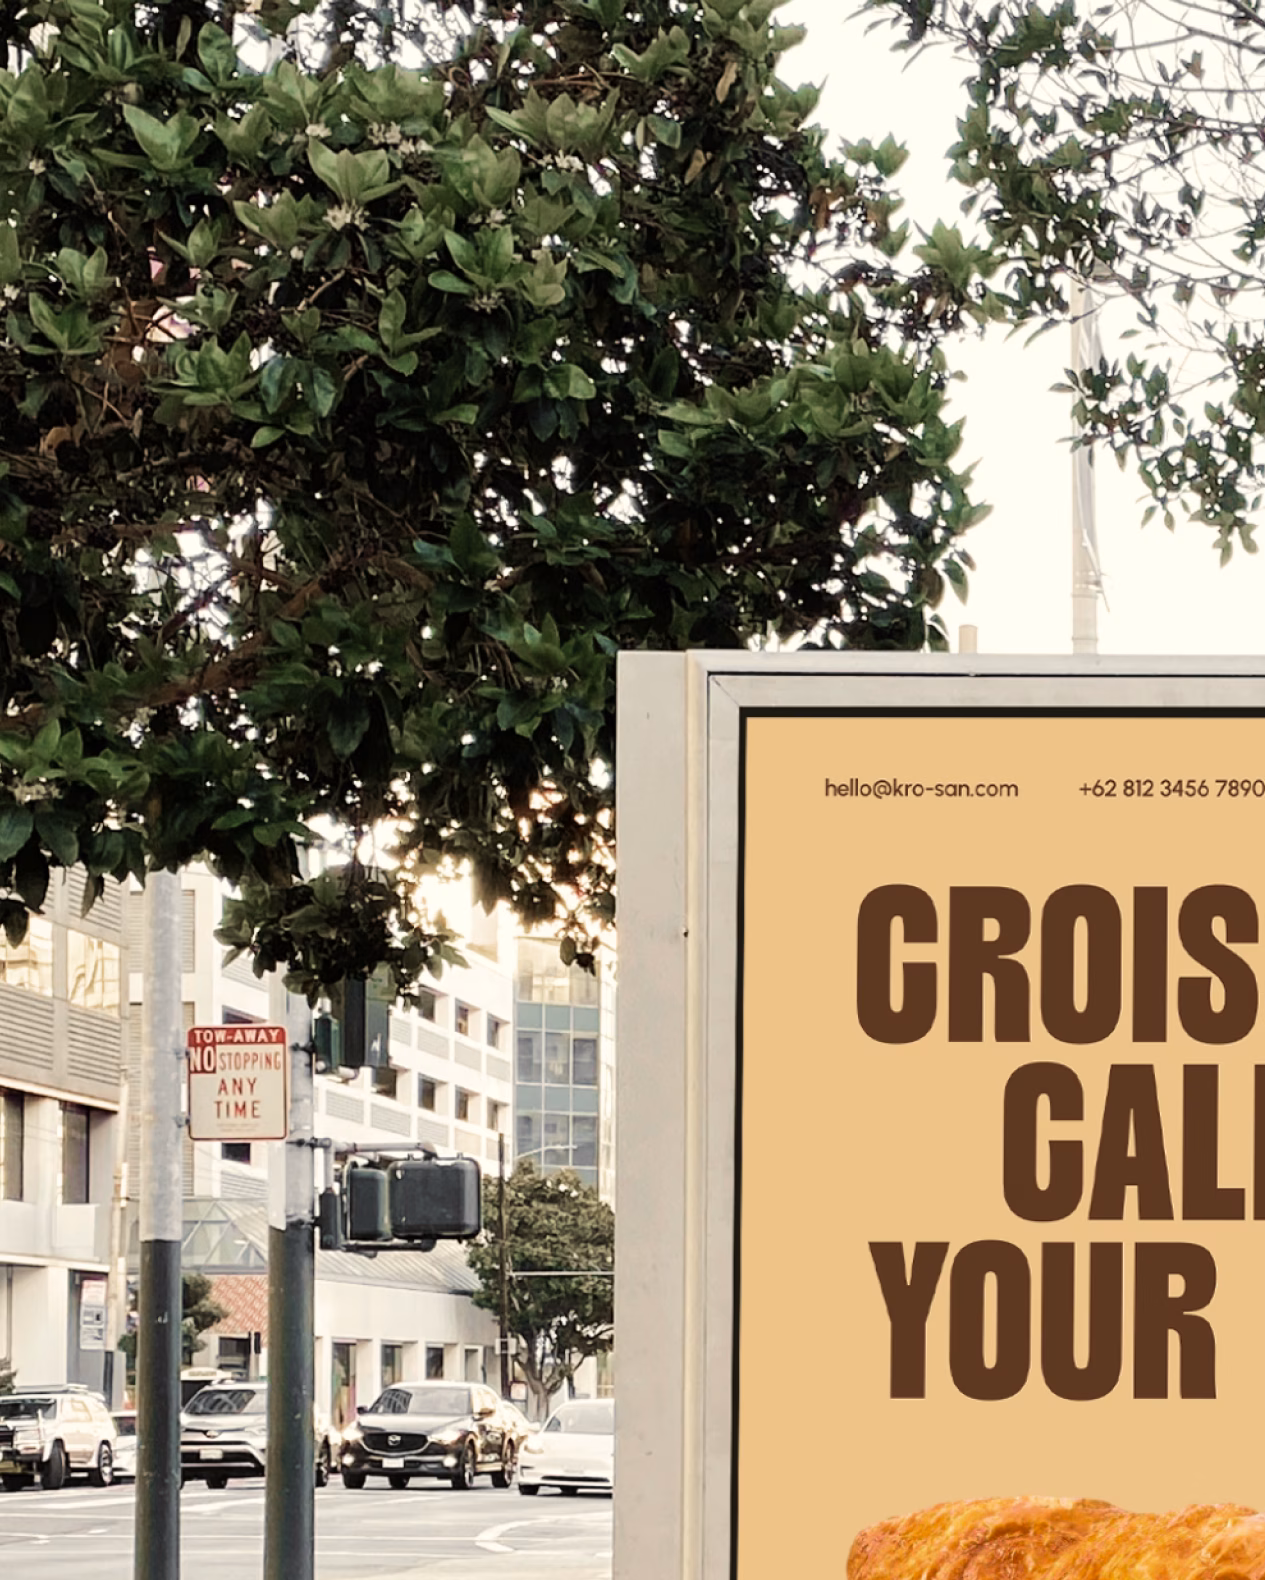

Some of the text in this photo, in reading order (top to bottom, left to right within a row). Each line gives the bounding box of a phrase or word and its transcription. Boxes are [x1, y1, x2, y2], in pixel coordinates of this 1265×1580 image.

[824, 778, 1019, 800] hello@kro-san.com
[1078, 778, 1265, 798] +62 812 3456 7890
[194, 1029, 280, 1043] TOW-AWAY
[189, 1046, 281, 1072] NO STOPPING
[217, 1077, 257, 1096] ANY
[214, 1100, 261, 1119] TIME
[867, 1239, 1218, 1402] YOUR
